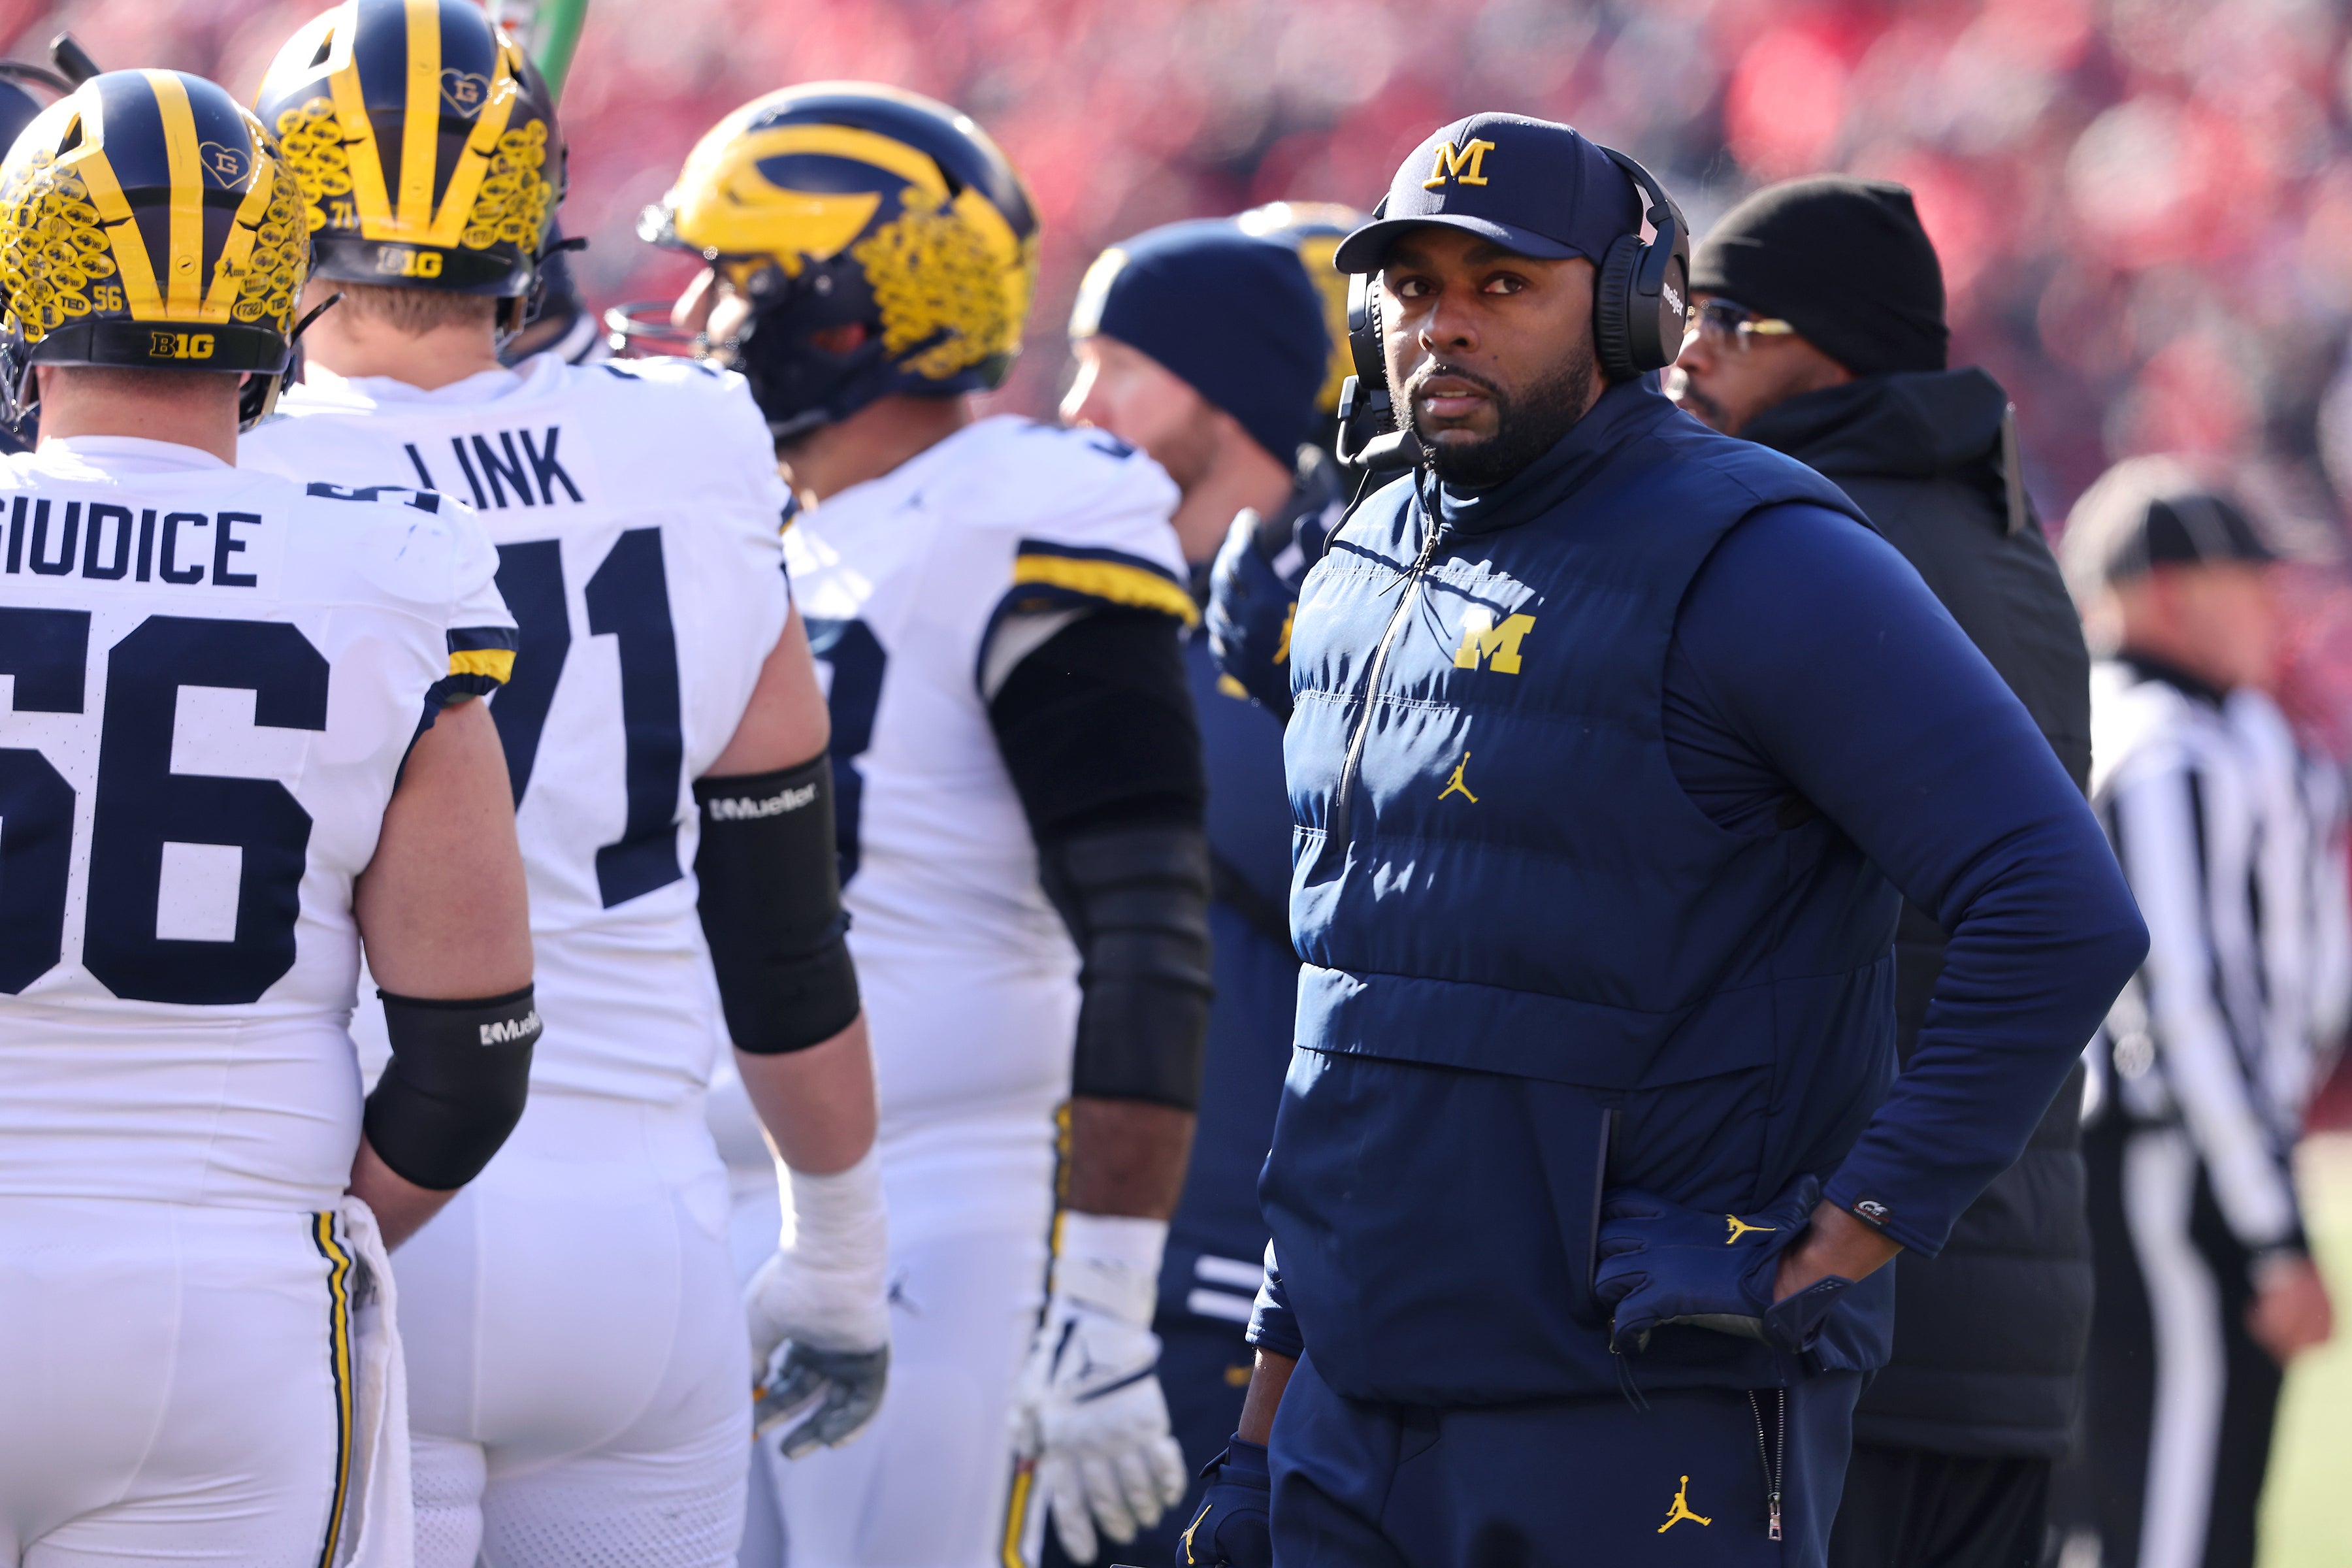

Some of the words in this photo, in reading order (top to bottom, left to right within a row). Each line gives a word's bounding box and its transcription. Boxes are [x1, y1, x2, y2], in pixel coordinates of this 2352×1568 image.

[454, 80, 479, 103] G
[215, 152, 239, 175] G
[1422, 138, 1495, 189] M
[329, 201, 353, 228] 71
[60, 295, 86, 310] TED
[93, 285, 123, 311] 56
[1663, 282, 1684, 317] meijer
[404, 426, 585, 510] LINK
[0, 495, 262, 588] IUDICE
[1454, 608, 1537, 674] M
[727, 783, 816, 820] Mueller
